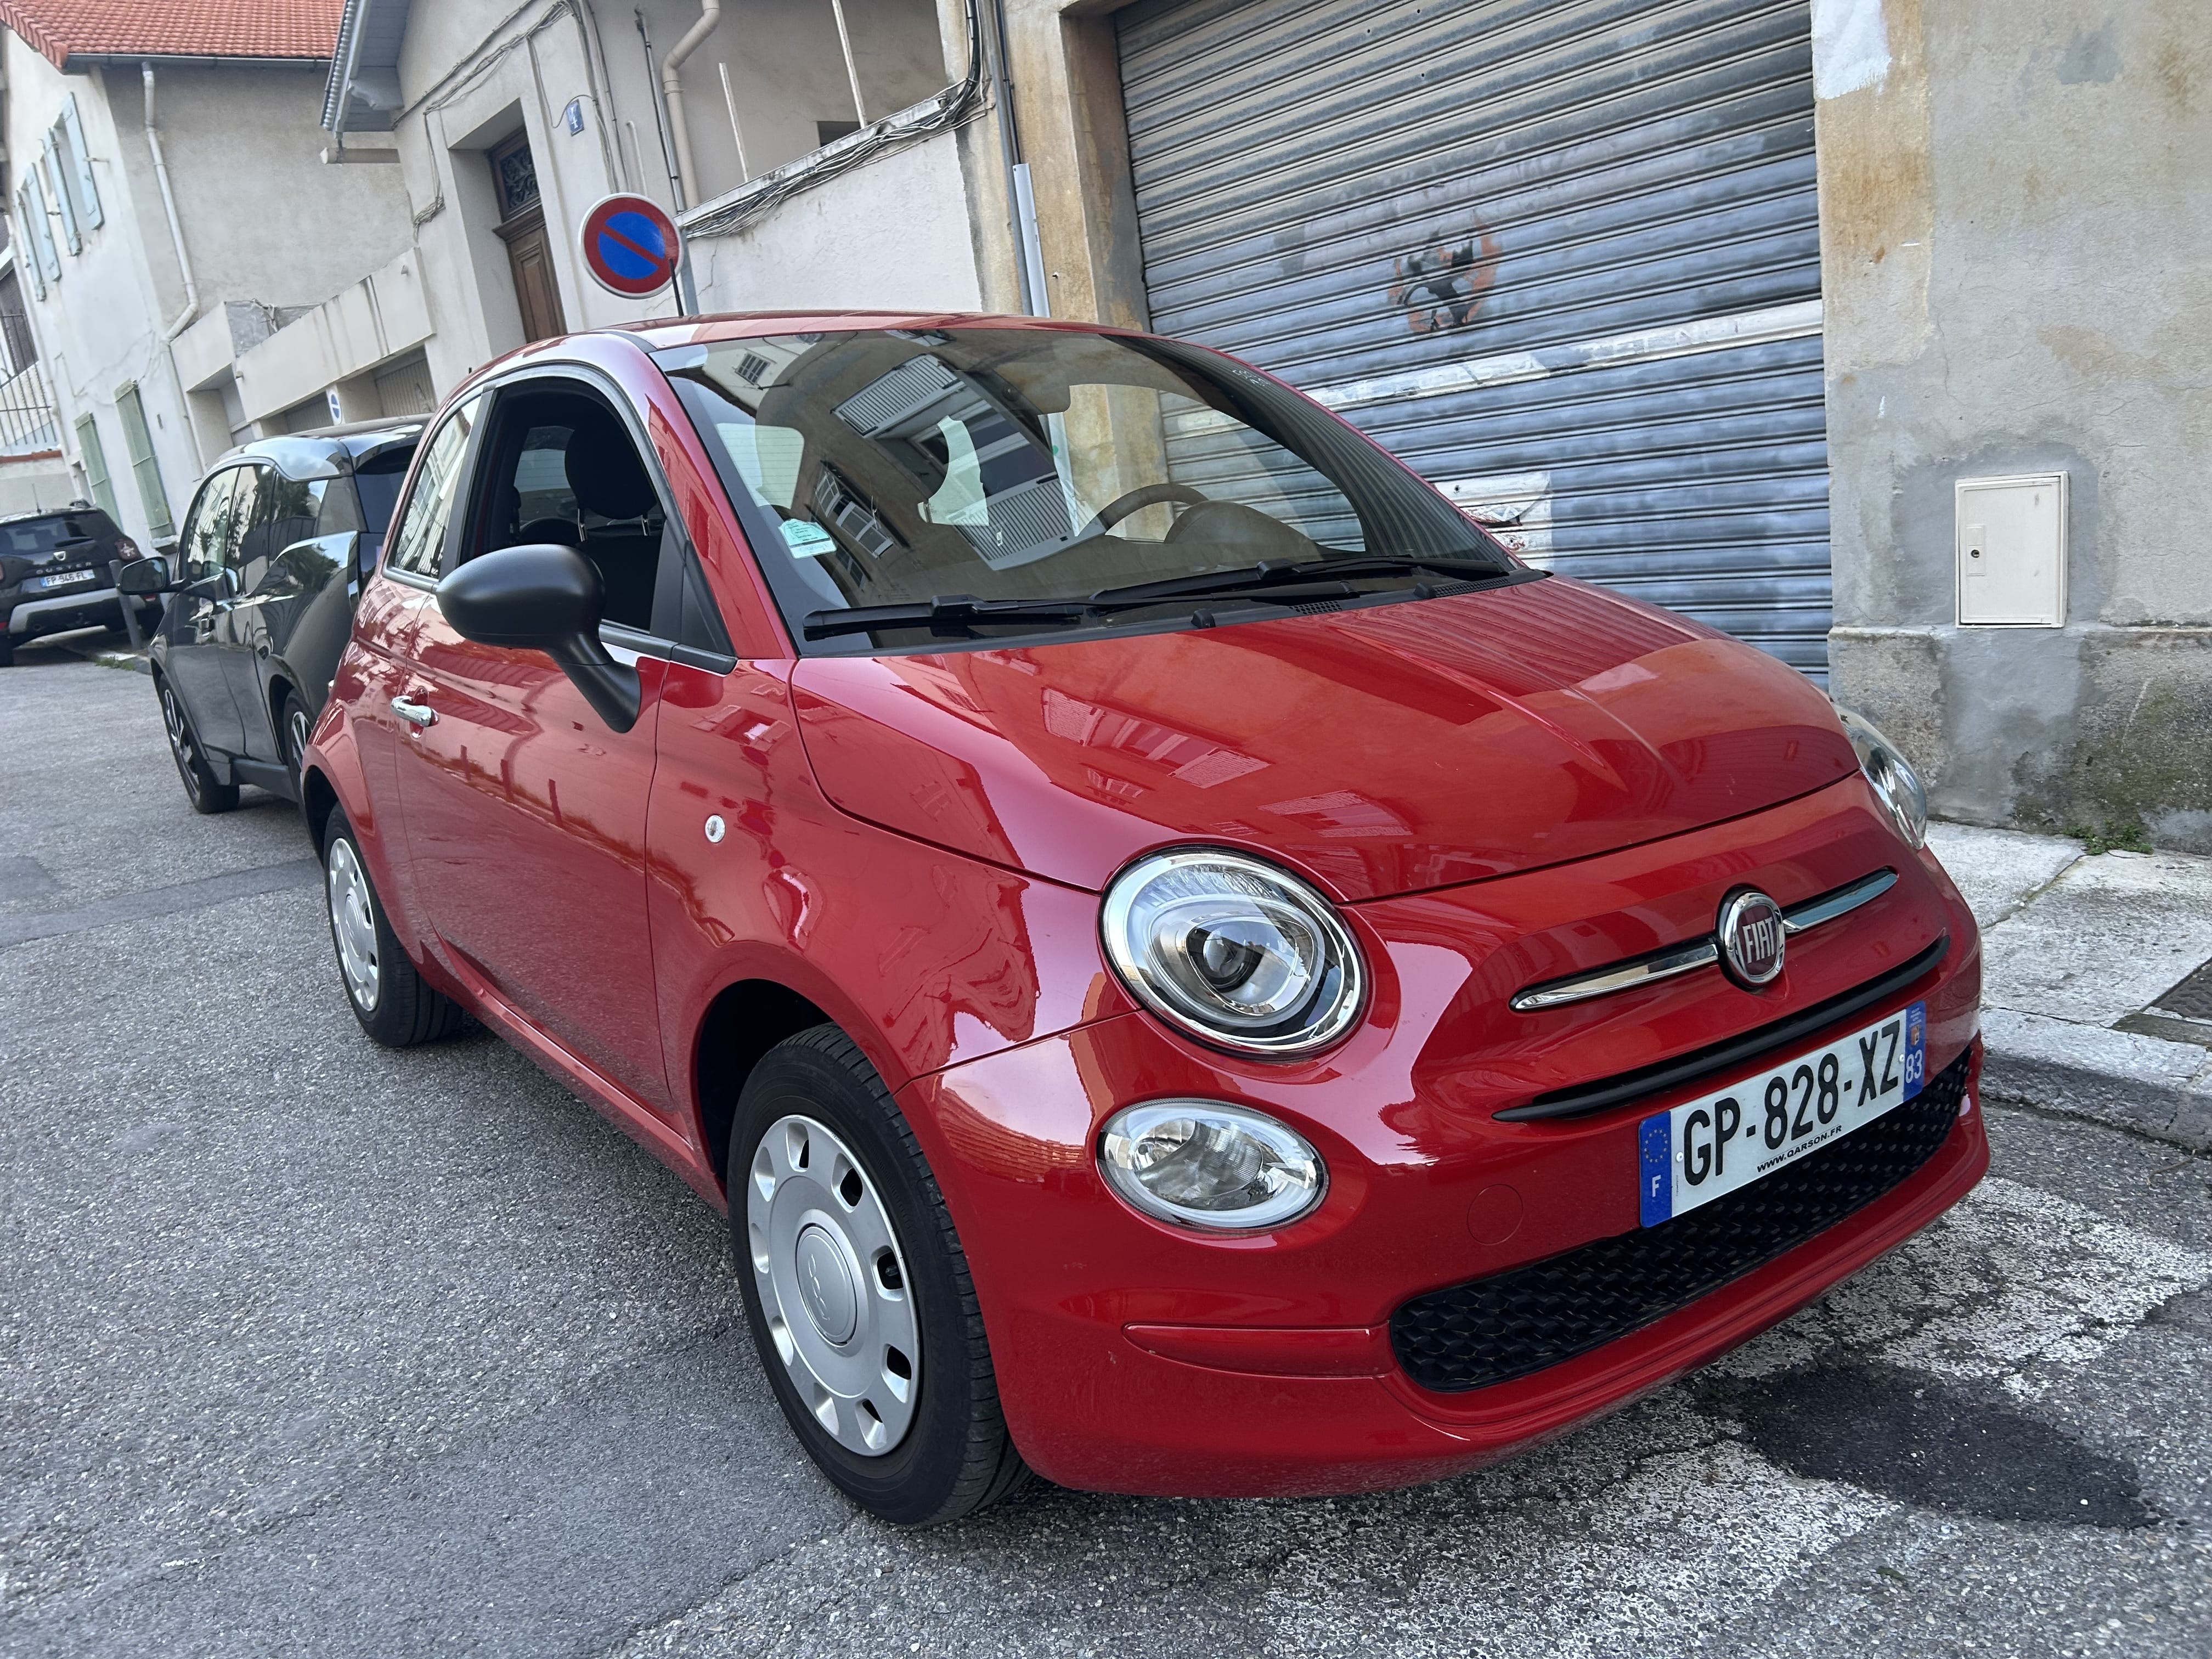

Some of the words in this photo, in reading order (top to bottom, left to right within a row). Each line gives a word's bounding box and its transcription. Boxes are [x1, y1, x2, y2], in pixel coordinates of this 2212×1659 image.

[1742, 917, 1775, 964] FIAT
[1905, 1049, 1922, 1084] 83
[1683, 1019, 1900, 1186] GP-828-XZ
[1757, 1124, 1842, 1173] WWW.QARSON.FR
[1651, 1174, 1661, 1198] F
